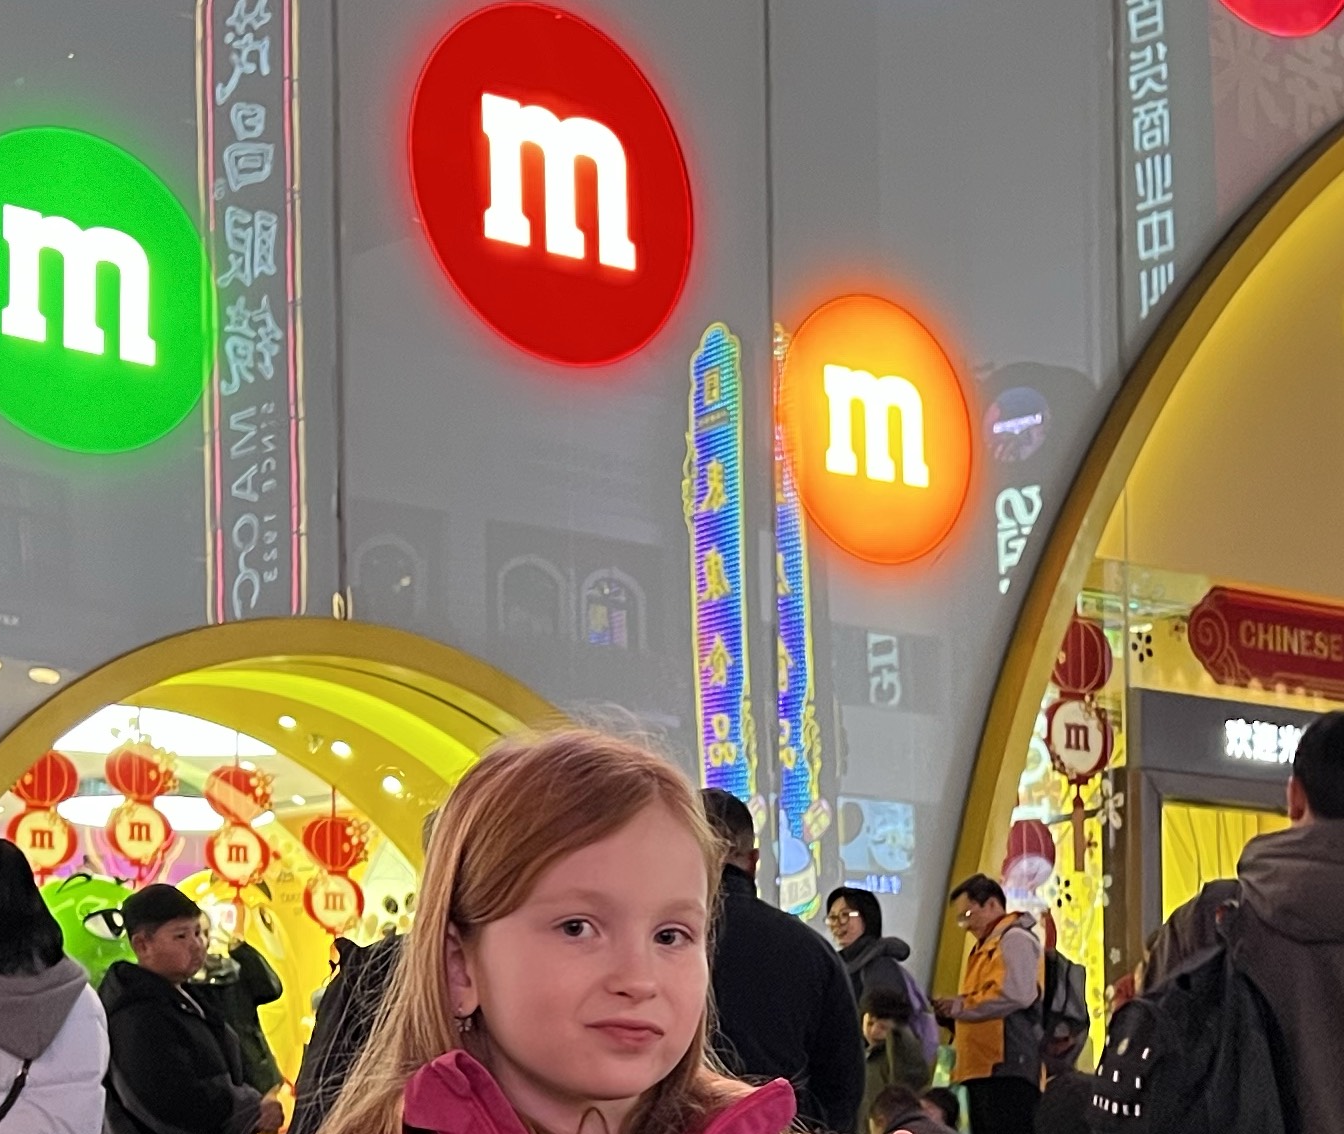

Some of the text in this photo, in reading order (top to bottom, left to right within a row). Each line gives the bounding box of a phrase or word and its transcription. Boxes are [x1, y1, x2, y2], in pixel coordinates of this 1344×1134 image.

[481, 92, 637, 272] m
[2, 203, 157, 367] m
[822, 363, 930, 489] m
